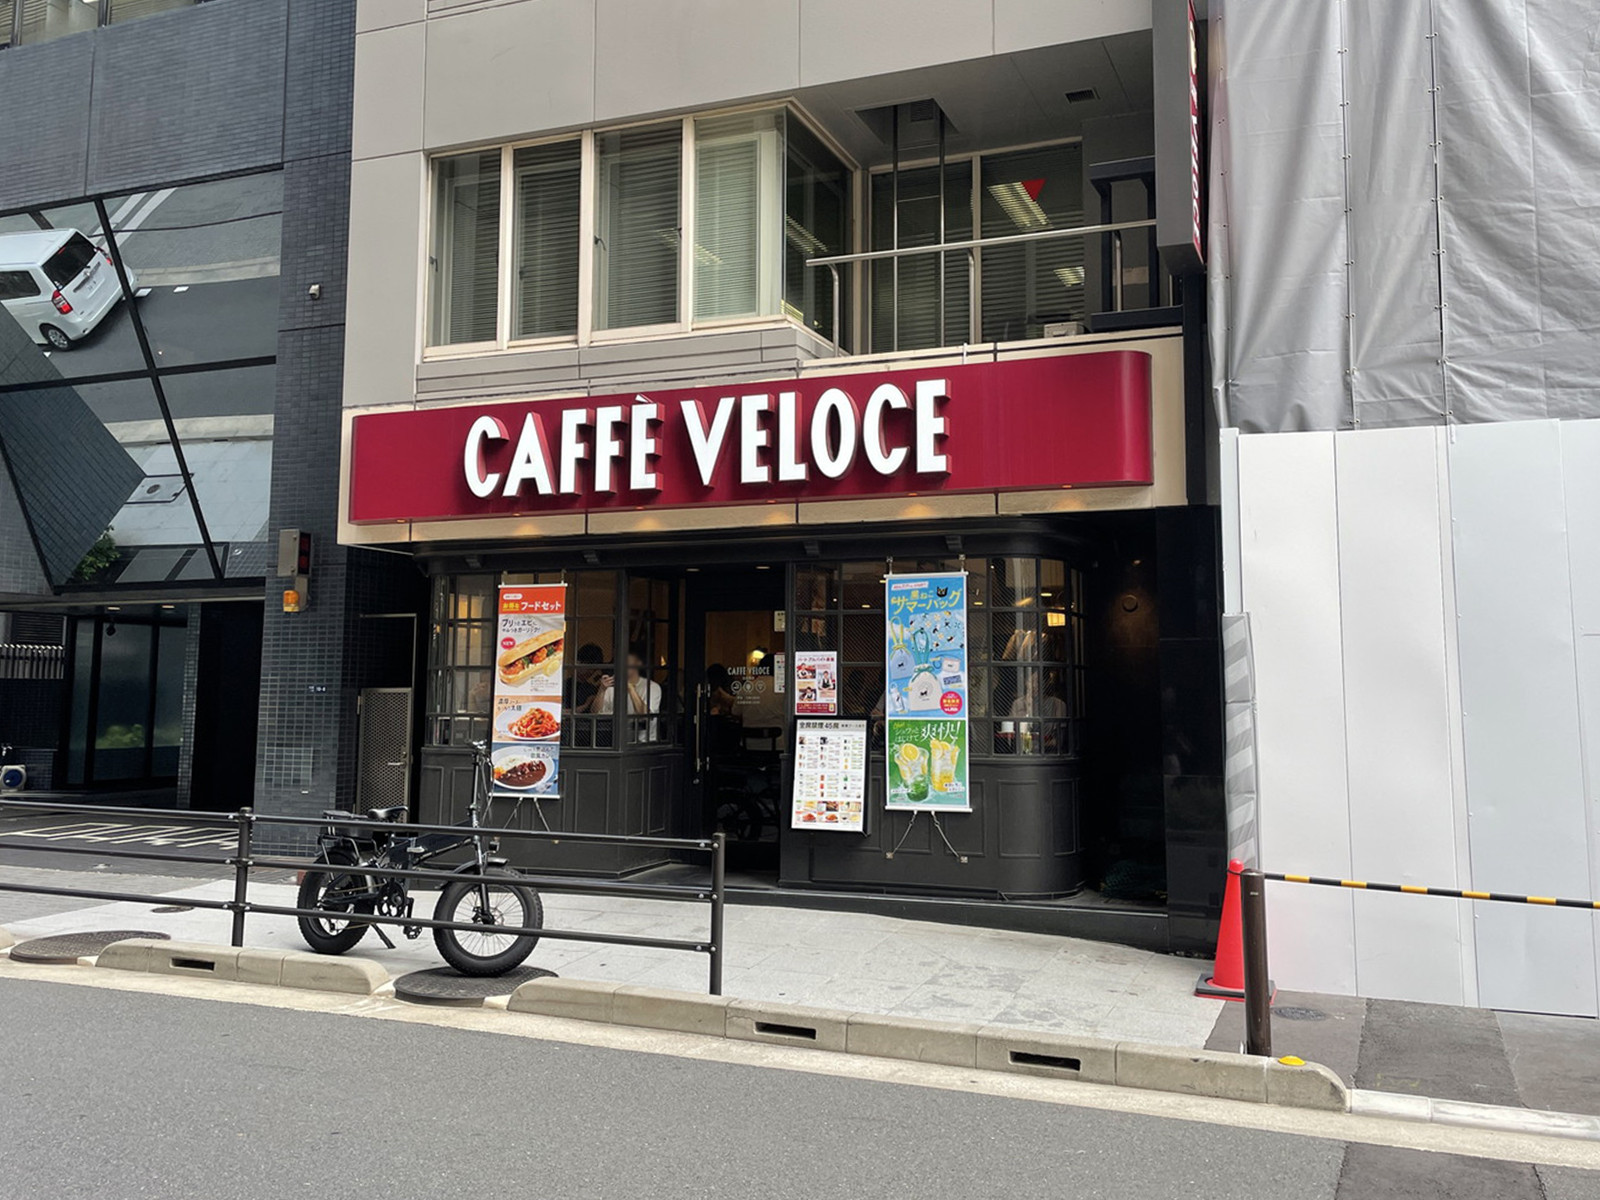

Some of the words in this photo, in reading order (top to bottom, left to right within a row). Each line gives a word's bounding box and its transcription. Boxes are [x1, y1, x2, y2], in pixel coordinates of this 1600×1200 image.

[464, 394, 664, 498] CAFFÈ
[680, 379, 951, 486] VELOCE
[521, 601, 561, 611] フードセット
